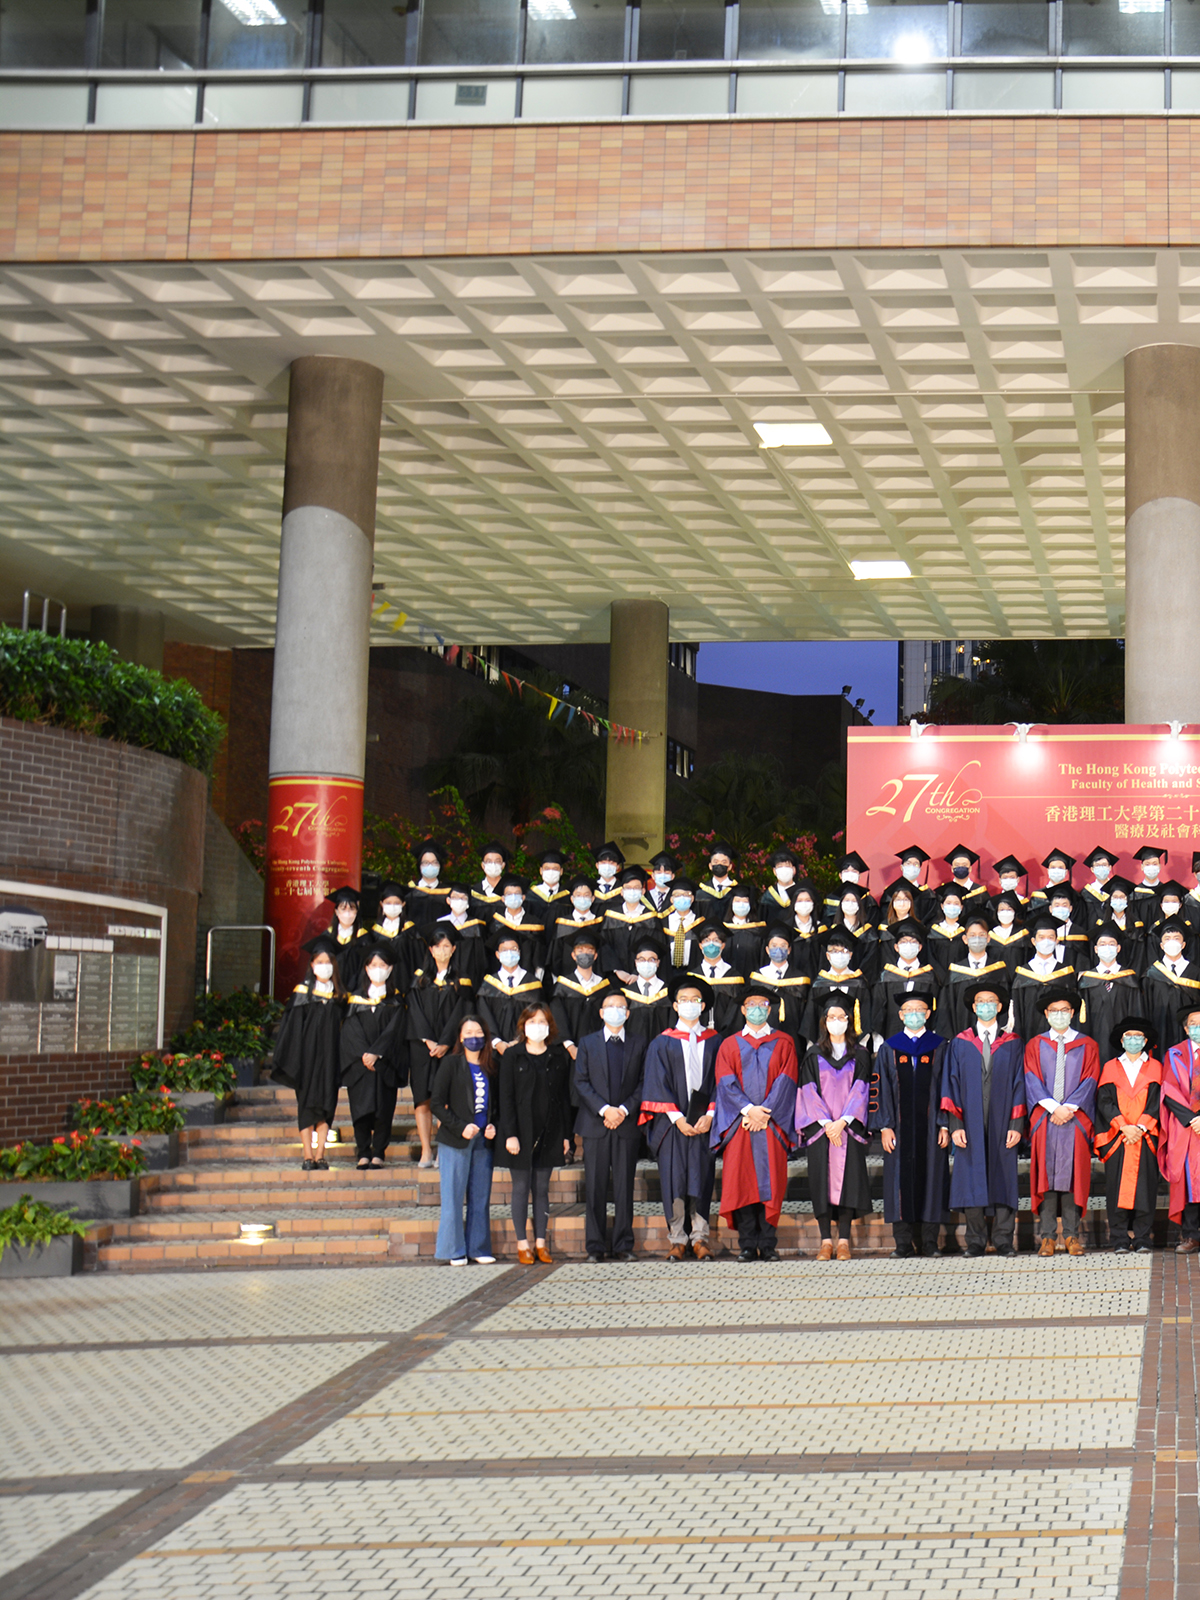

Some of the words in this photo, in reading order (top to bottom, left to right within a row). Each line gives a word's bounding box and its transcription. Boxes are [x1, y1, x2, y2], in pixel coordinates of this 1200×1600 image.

[1058, 763, 1083, 775] The
[1086, 763, 1119, 777] Hong
[1123, 763, 1156, 777] Kong
[865, 760, 983, 823] 27th
[1071, 779, 1113, 791] Faculty
[1116, 779, 1128, 789] of
[1131, 779, 1168, 789] Health
[1172, 779, 1192, 789] and
